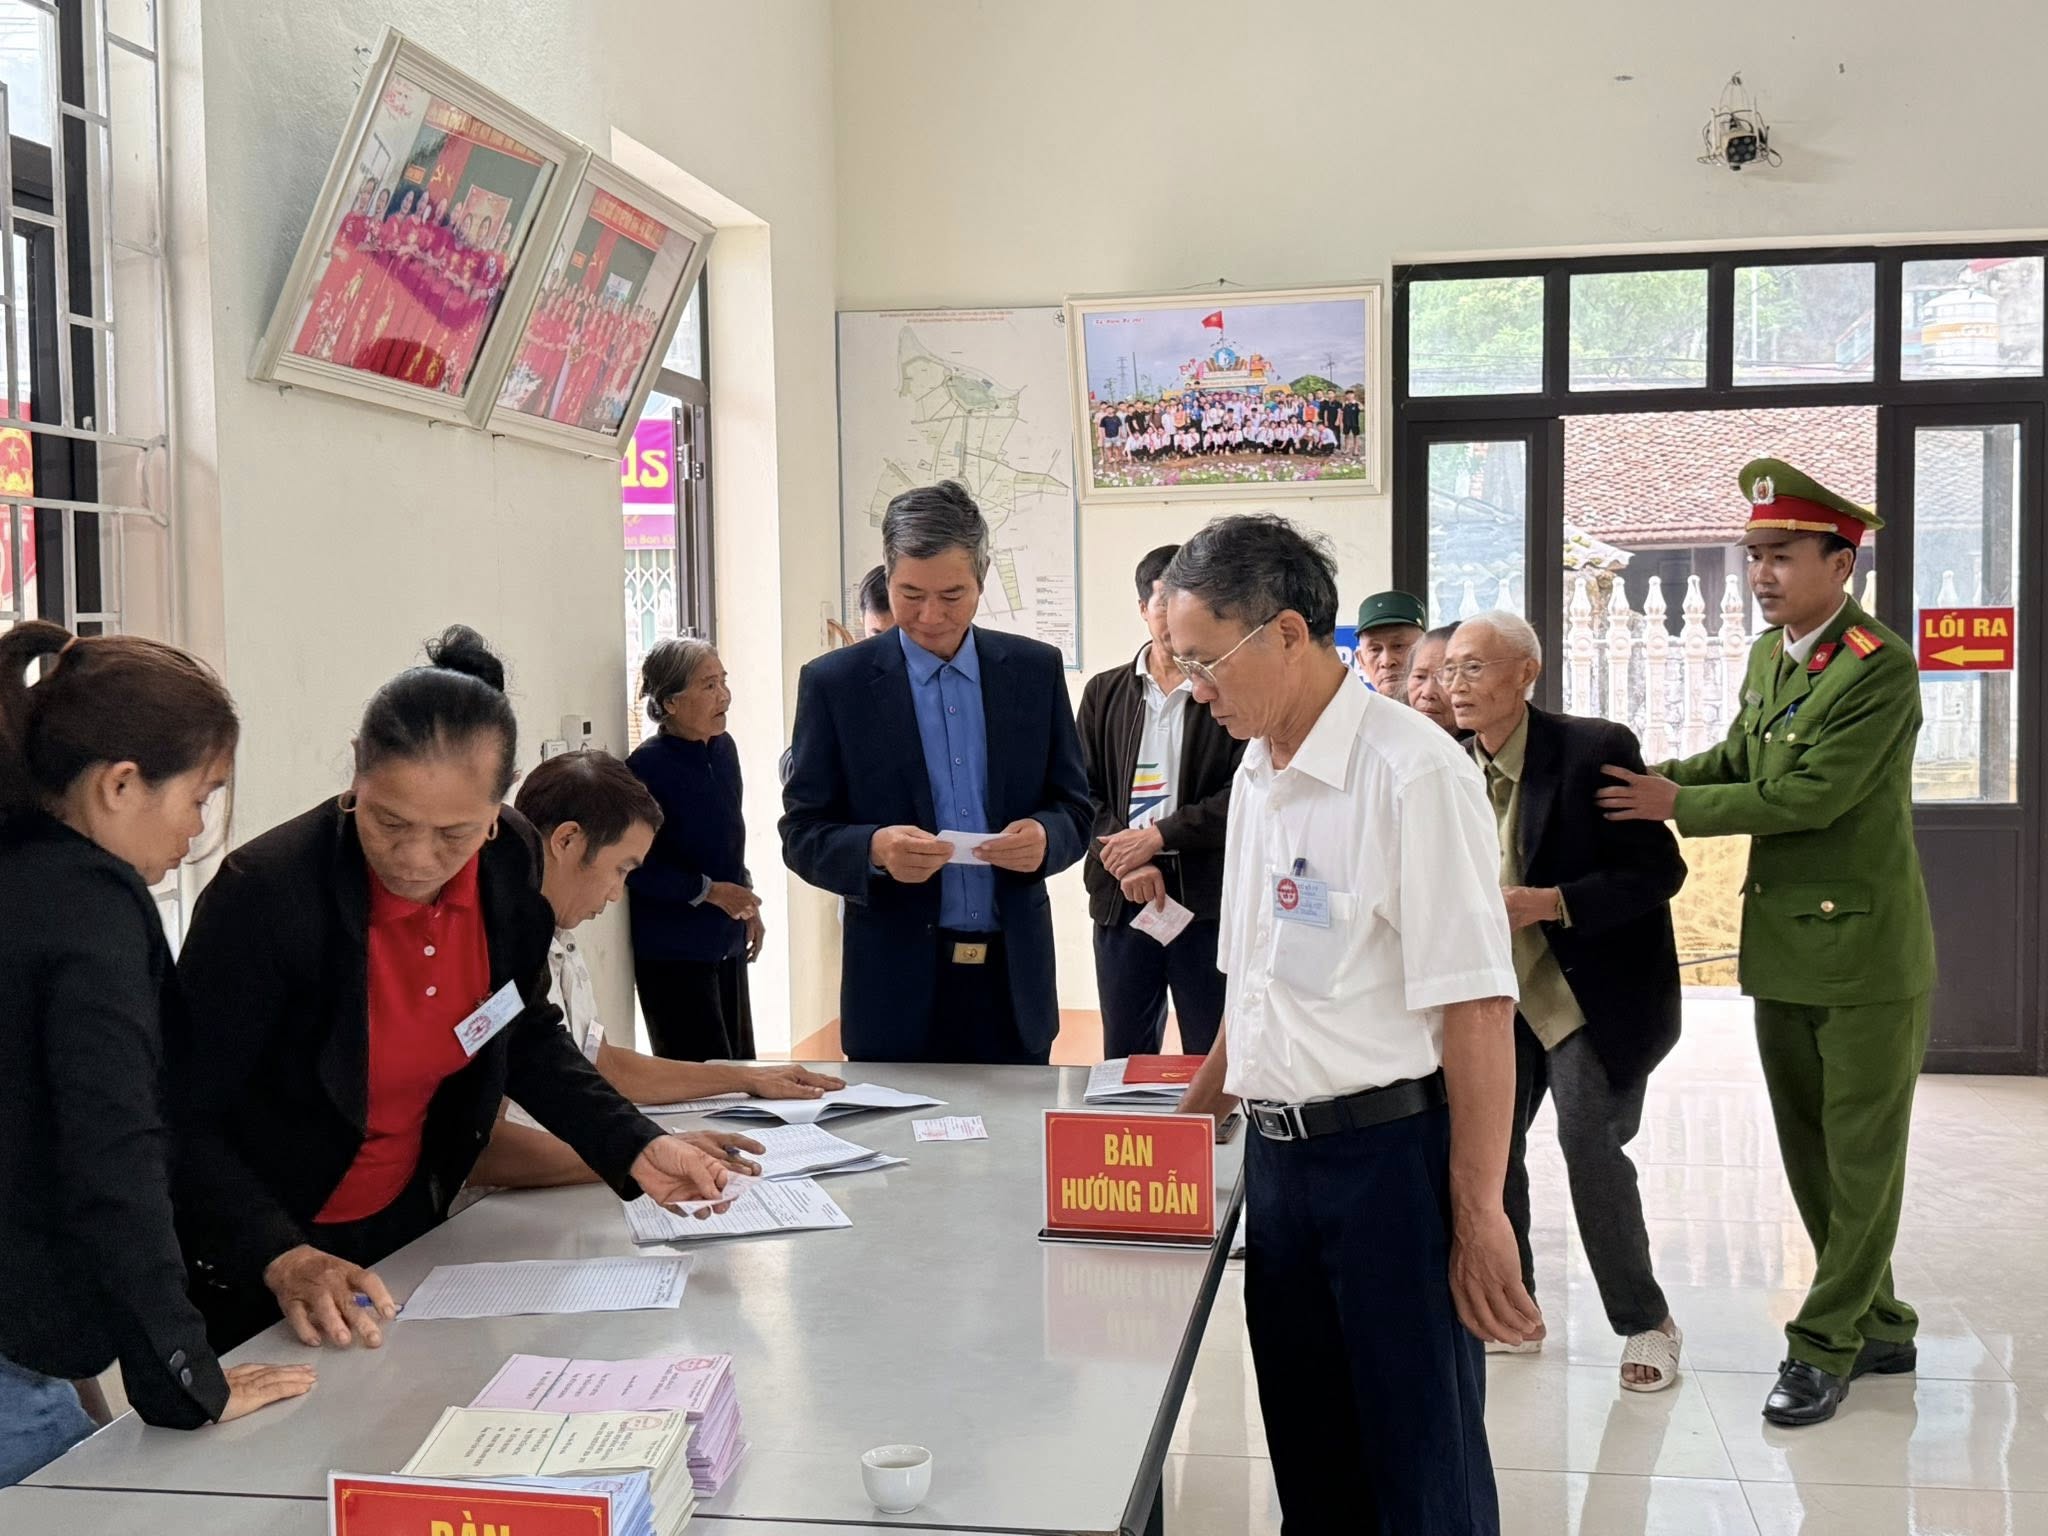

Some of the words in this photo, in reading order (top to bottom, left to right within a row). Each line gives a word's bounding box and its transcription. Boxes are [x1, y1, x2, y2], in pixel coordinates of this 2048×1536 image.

[1925, 611, 1965, 638] LỐI
[1973, 617, 2008, 637] RA
[1104, 1127, 1153, 1167] BÀN
[1061, 1172, 1141, 1213] HƯỚNG
[1149, 1169, 1198, 1215] DẪN
